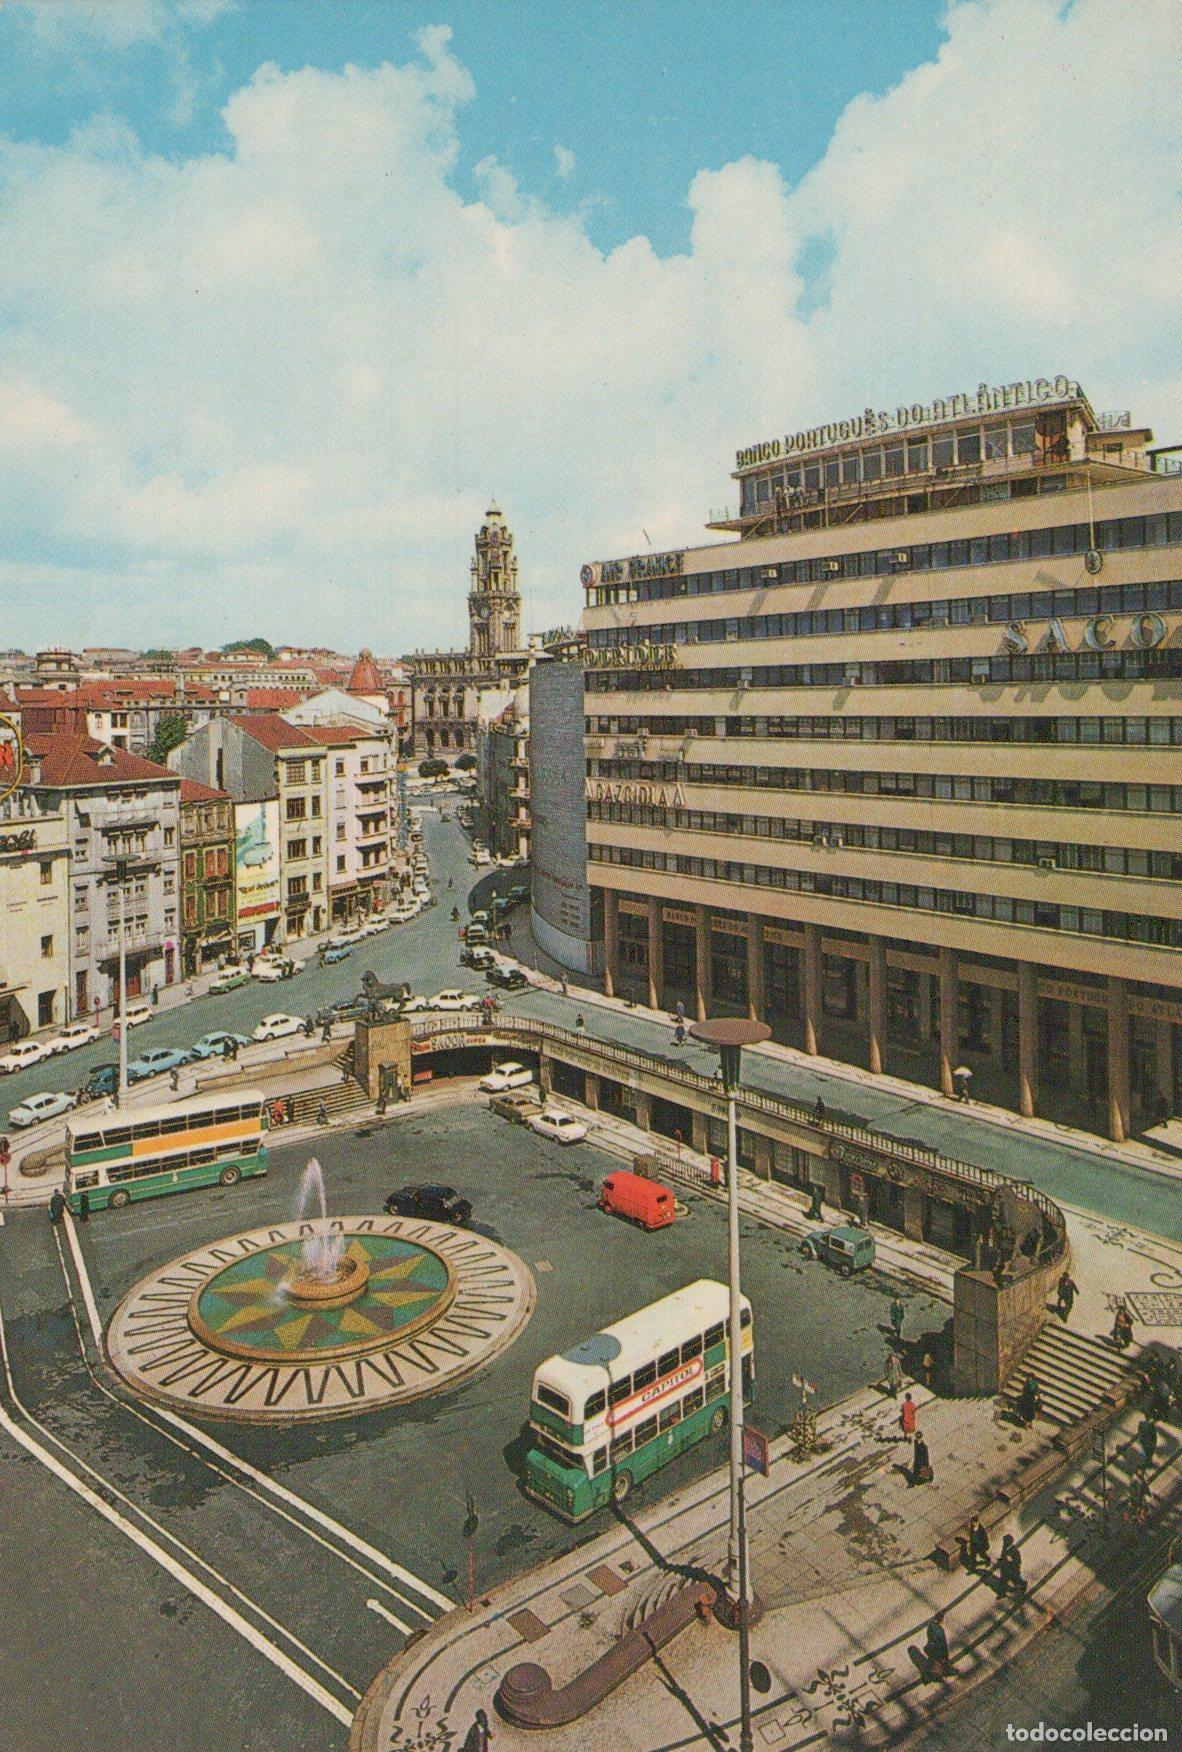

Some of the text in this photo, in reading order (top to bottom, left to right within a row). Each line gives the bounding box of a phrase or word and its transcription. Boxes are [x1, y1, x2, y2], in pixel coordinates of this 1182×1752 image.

[736, 374, 1069, 469] BANCO PORTUGUÊS DO ATLÂNTICO
